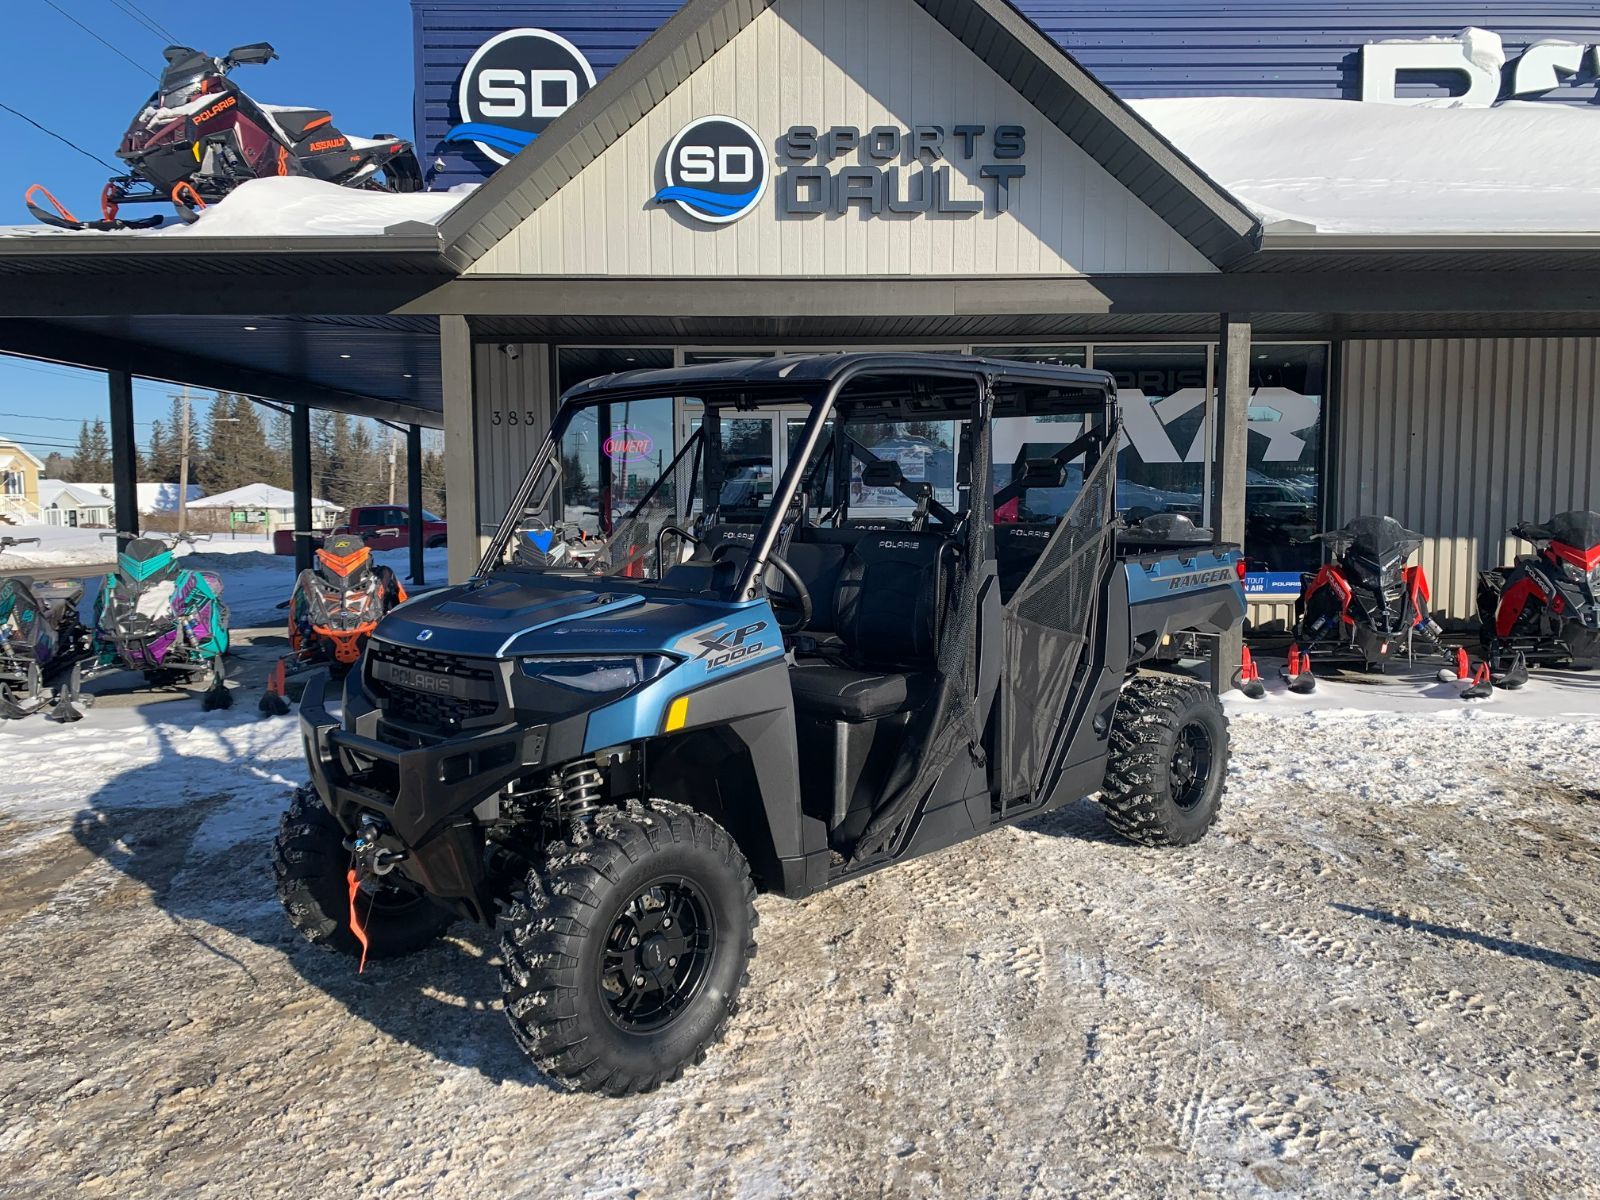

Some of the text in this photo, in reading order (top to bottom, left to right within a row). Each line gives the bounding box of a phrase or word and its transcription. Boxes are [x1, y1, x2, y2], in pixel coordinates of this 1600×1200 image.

[478, 69, 578, 118] SD
[192, 96, 237, 126] POLARIS
[309, 137, 347, 152] ASSAULT
[787, 125, 1026, 160] SPORTS
[679, 145, 754, 183] SD
[786, 165, 1026, 214] DAULT
[606, 439, 650, 453] OUVERT
[878, 540, 920, 550] POLARIS
[1010, 529, 1050, 539] POLARIS
[1168, 568, 1230, 590] RANGER
[1247, 577, 1264, 585] TOUT
[690, 620, 769, 663] XP
[705, 641, 764, 670] 1000
[391, 666, 450, 693] POLARIS
